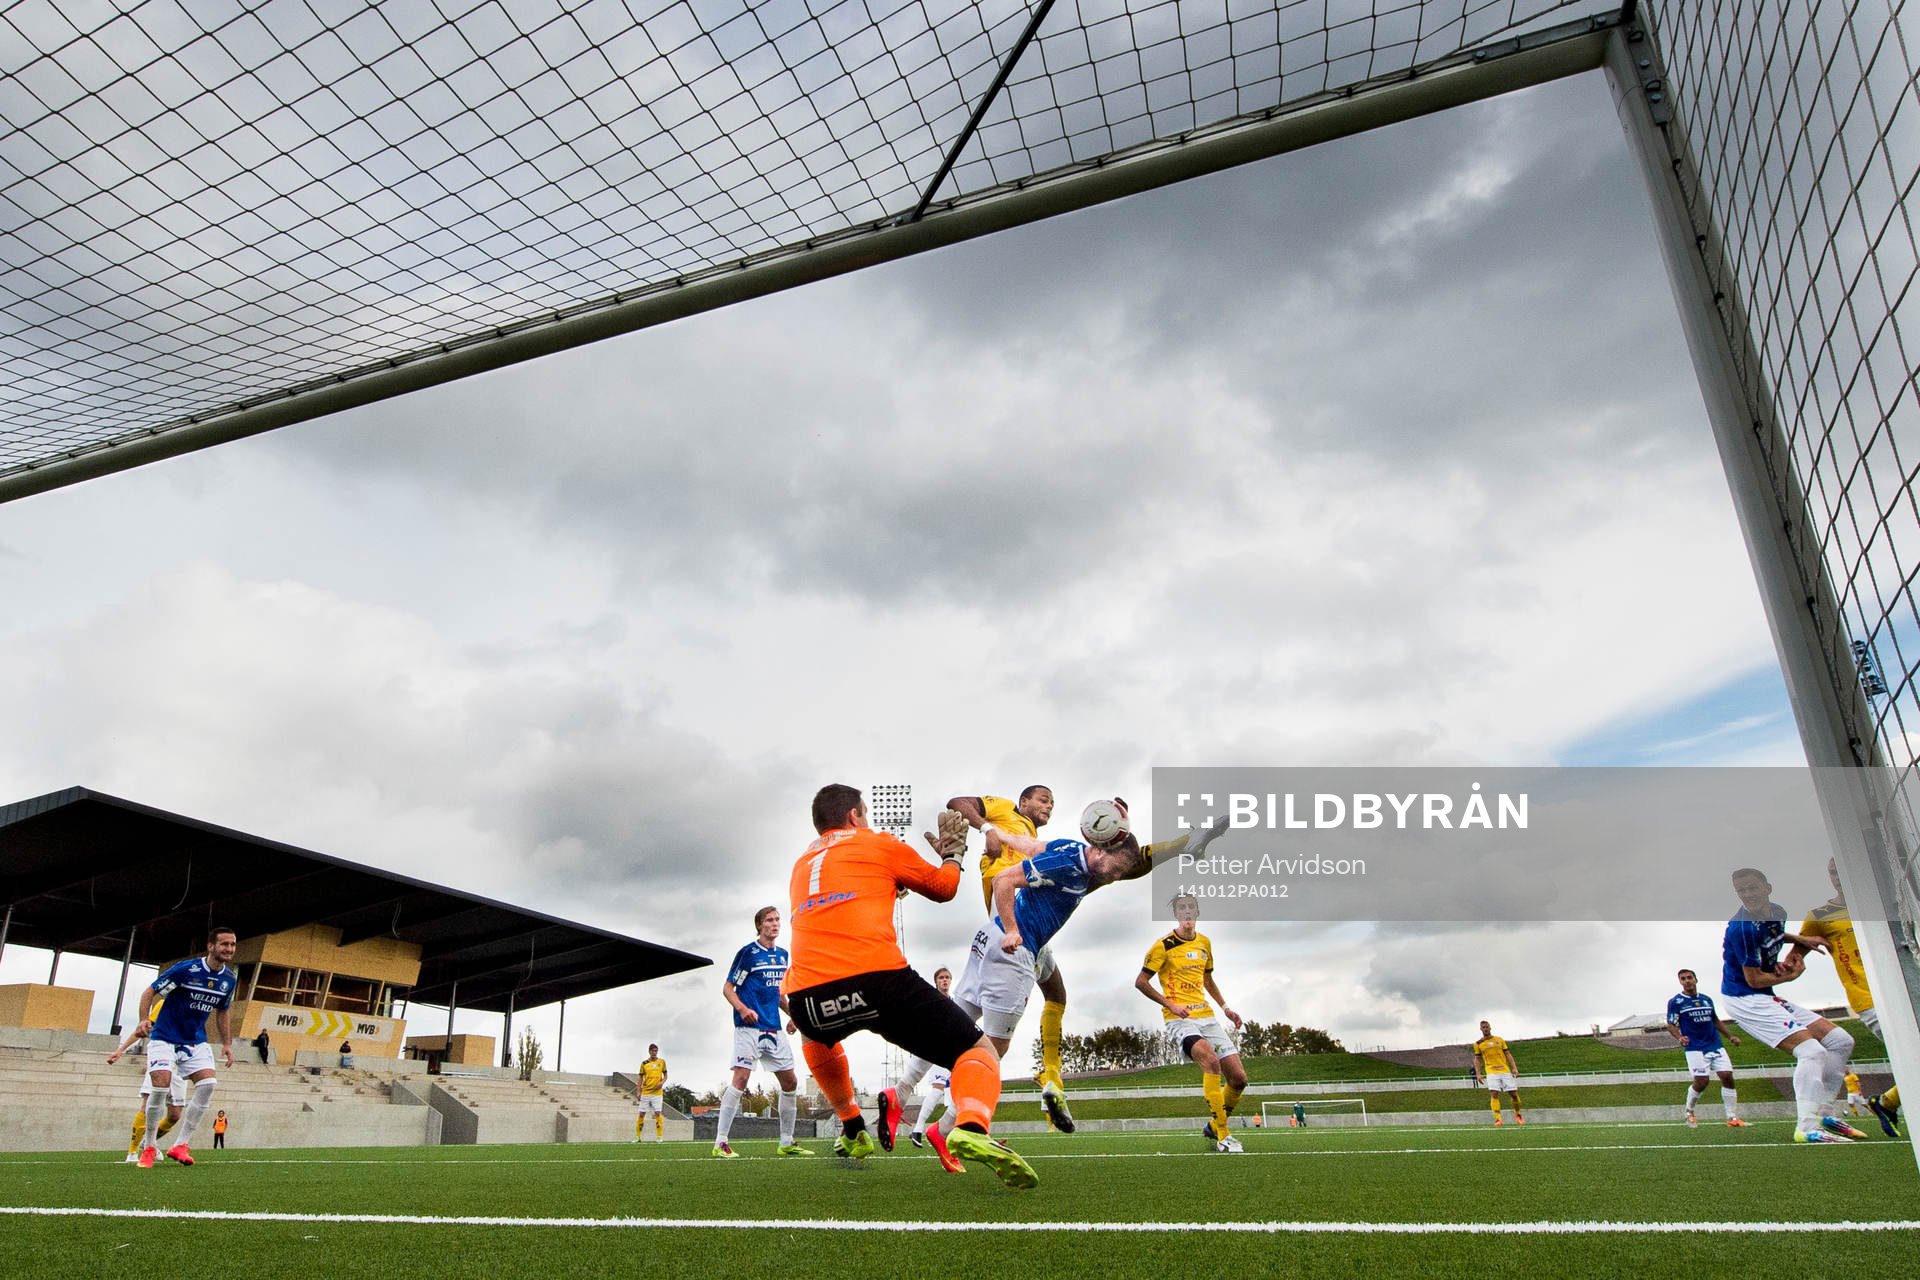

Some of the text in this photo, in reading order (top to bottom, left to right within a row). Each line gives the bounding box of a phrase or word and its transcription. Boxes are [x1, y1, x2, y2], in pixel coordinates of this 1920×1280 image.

[807, 848, 829, 896] 1
[189, 992, 220, 1004] MELLBY
[820, 992, 868, 1017] BCA
[277, 1014, 376, 1035] MVB MVB
